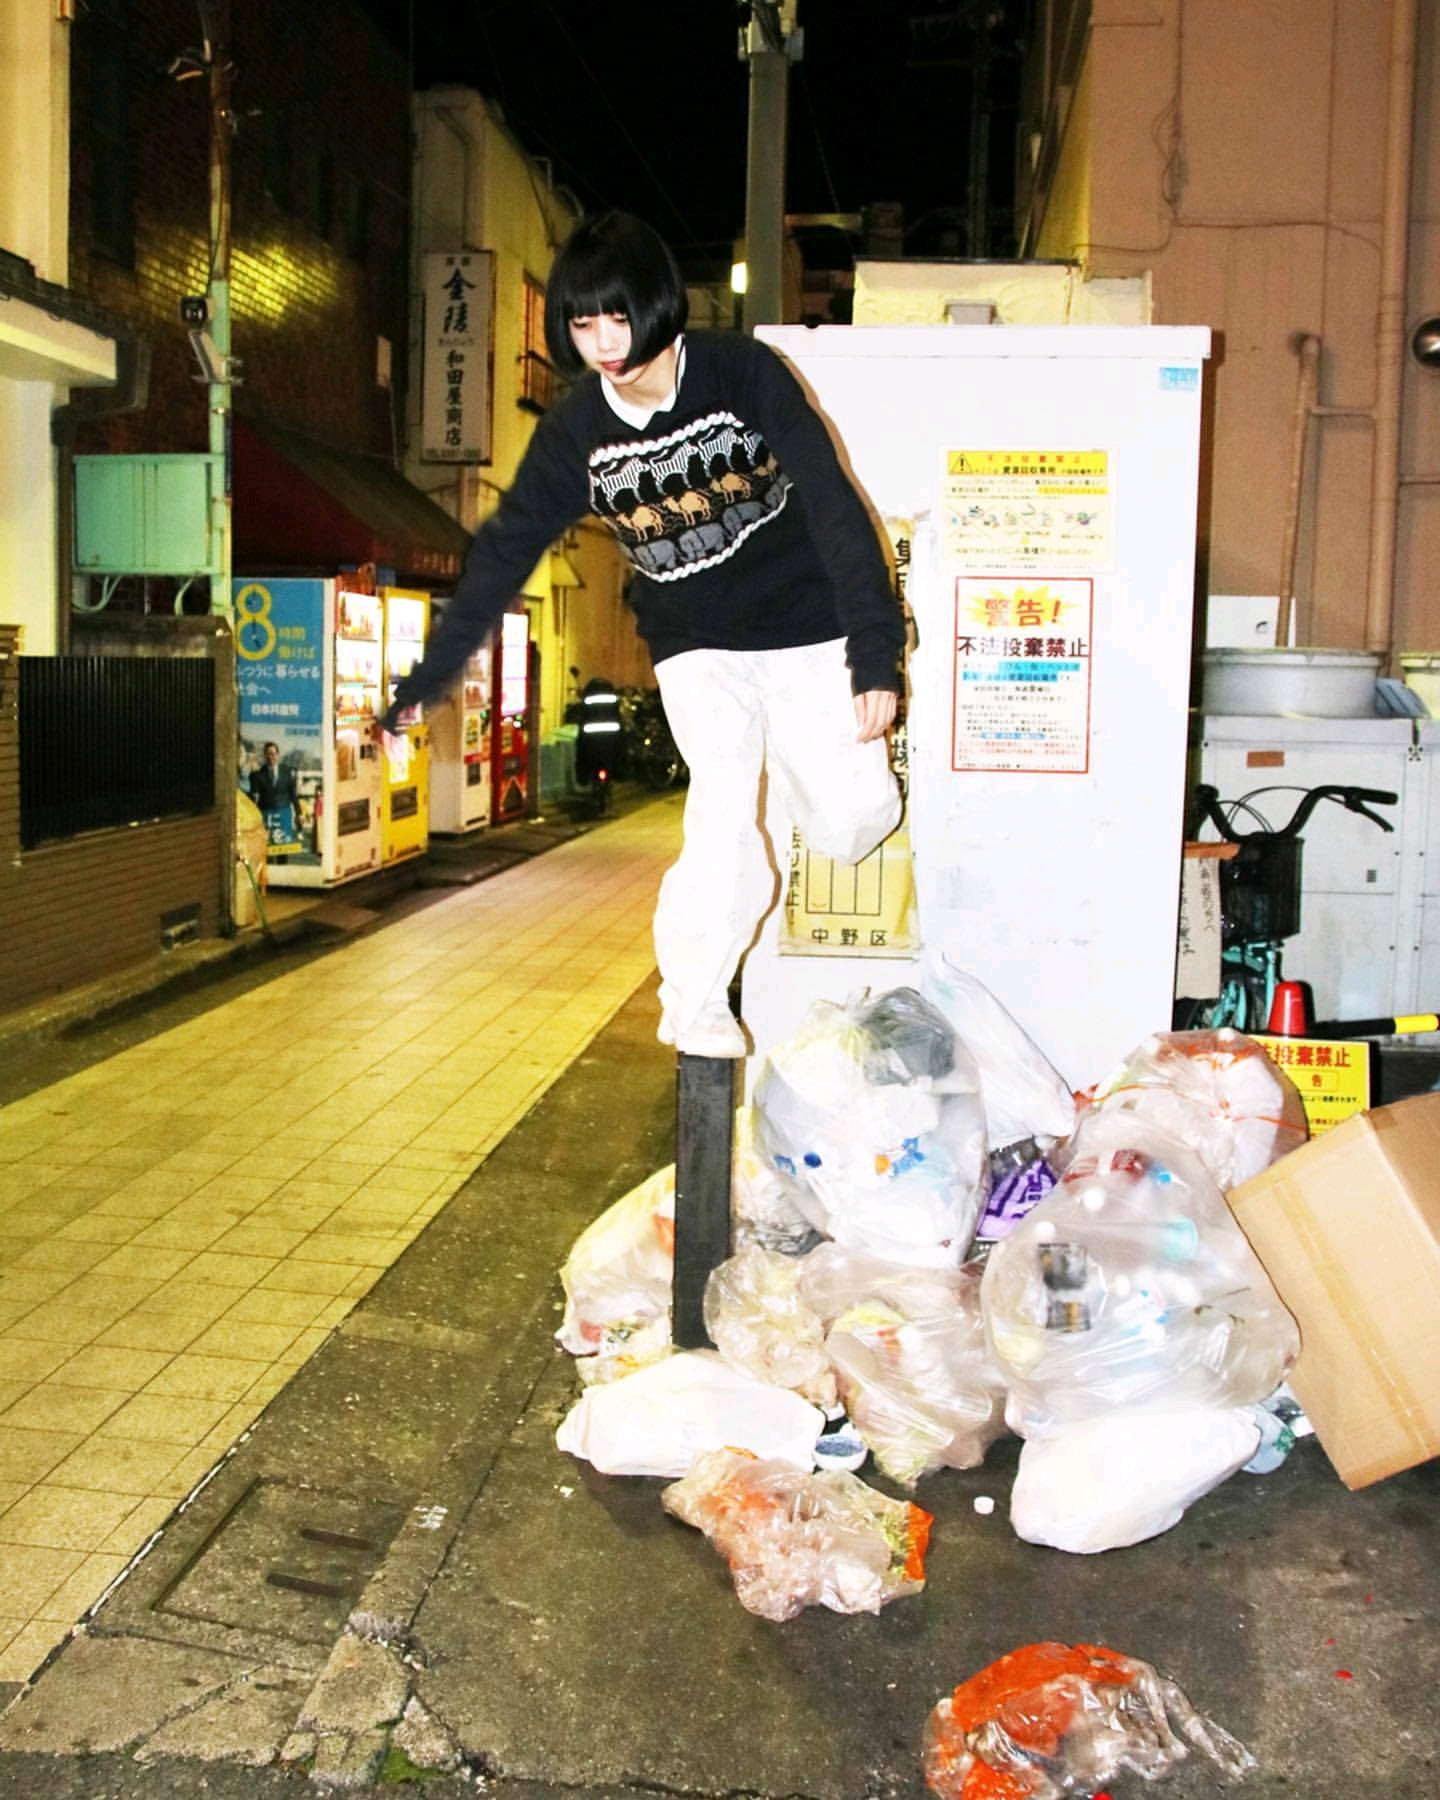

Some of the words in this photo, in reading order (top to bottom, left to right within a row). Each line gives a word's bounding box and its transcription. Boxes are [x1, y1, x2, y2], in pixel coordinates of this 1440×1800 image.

[444, 349, 465, 446] 和田屋商店
[957, 636, 1089, 658] 不法投棄禁止
[251, 703, 299, 717] 日本共産党
[811, 928, 888, 946] 中野区
